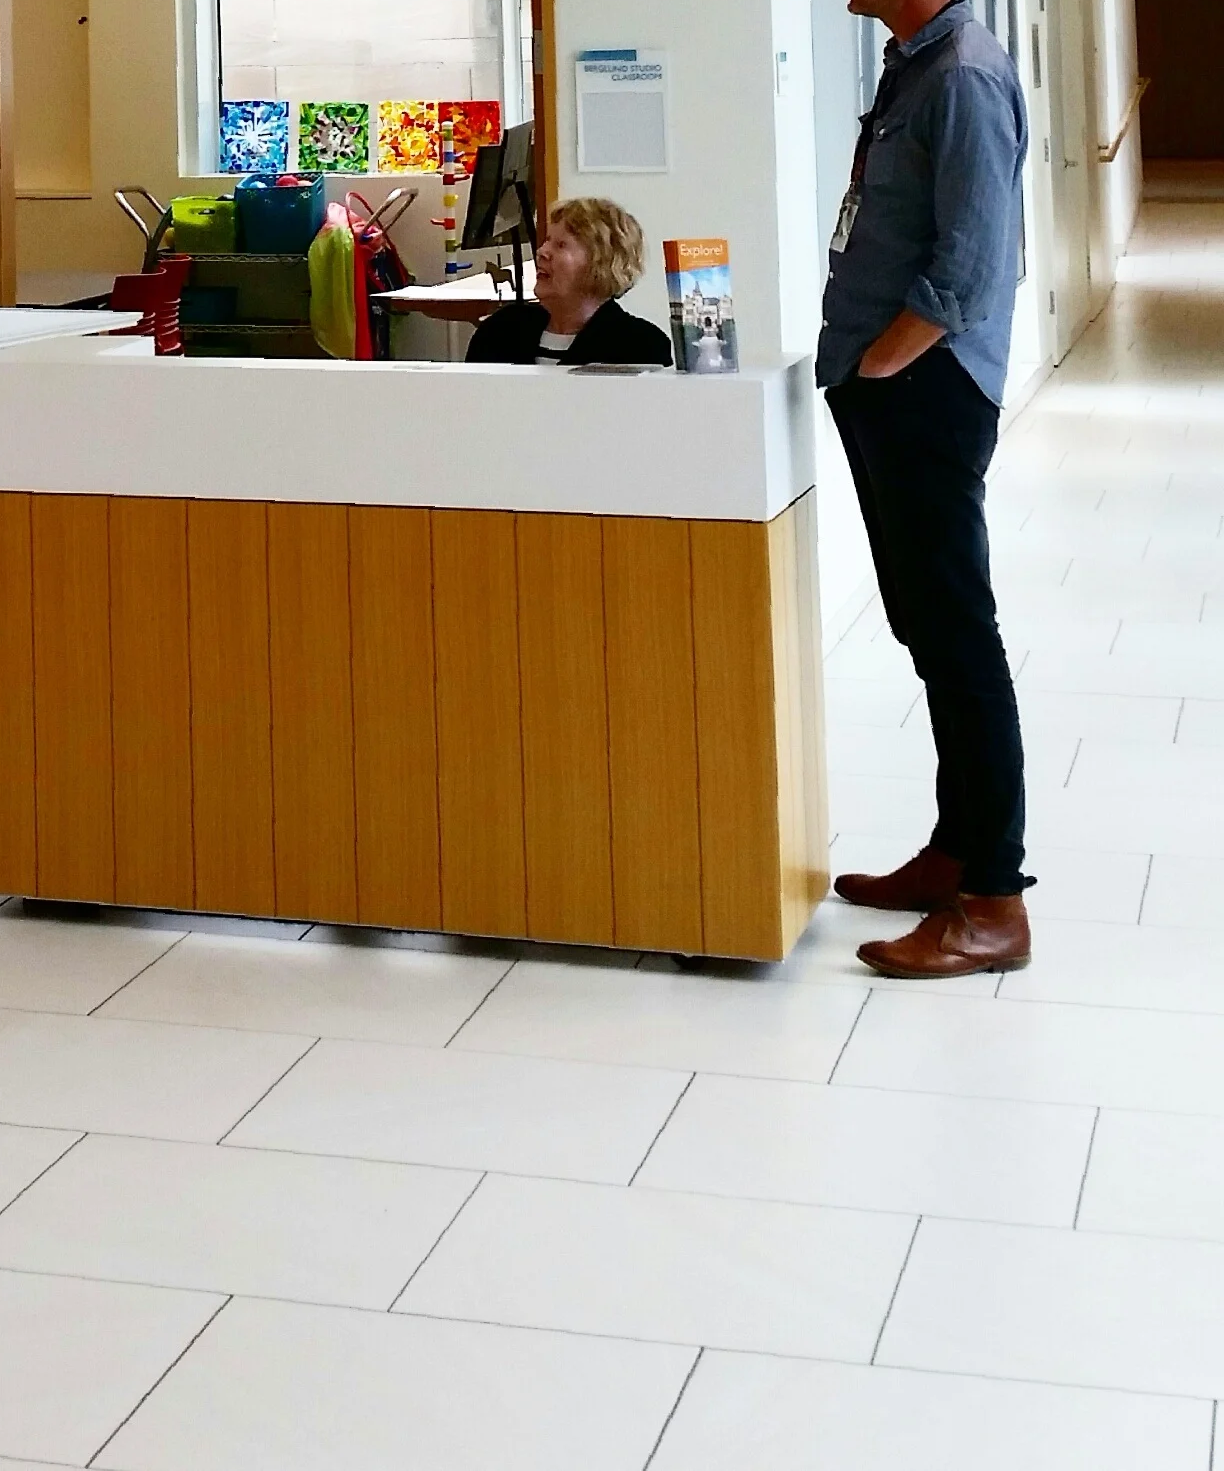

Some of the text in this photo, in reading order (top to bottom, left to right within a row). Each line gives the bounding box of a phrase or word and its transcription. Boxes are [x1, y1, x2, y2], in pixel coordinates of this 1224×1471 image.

[584, 64, 663, 72] BERGLUND STUDIO
[611, 73, 663, 81] CLASSROOM
